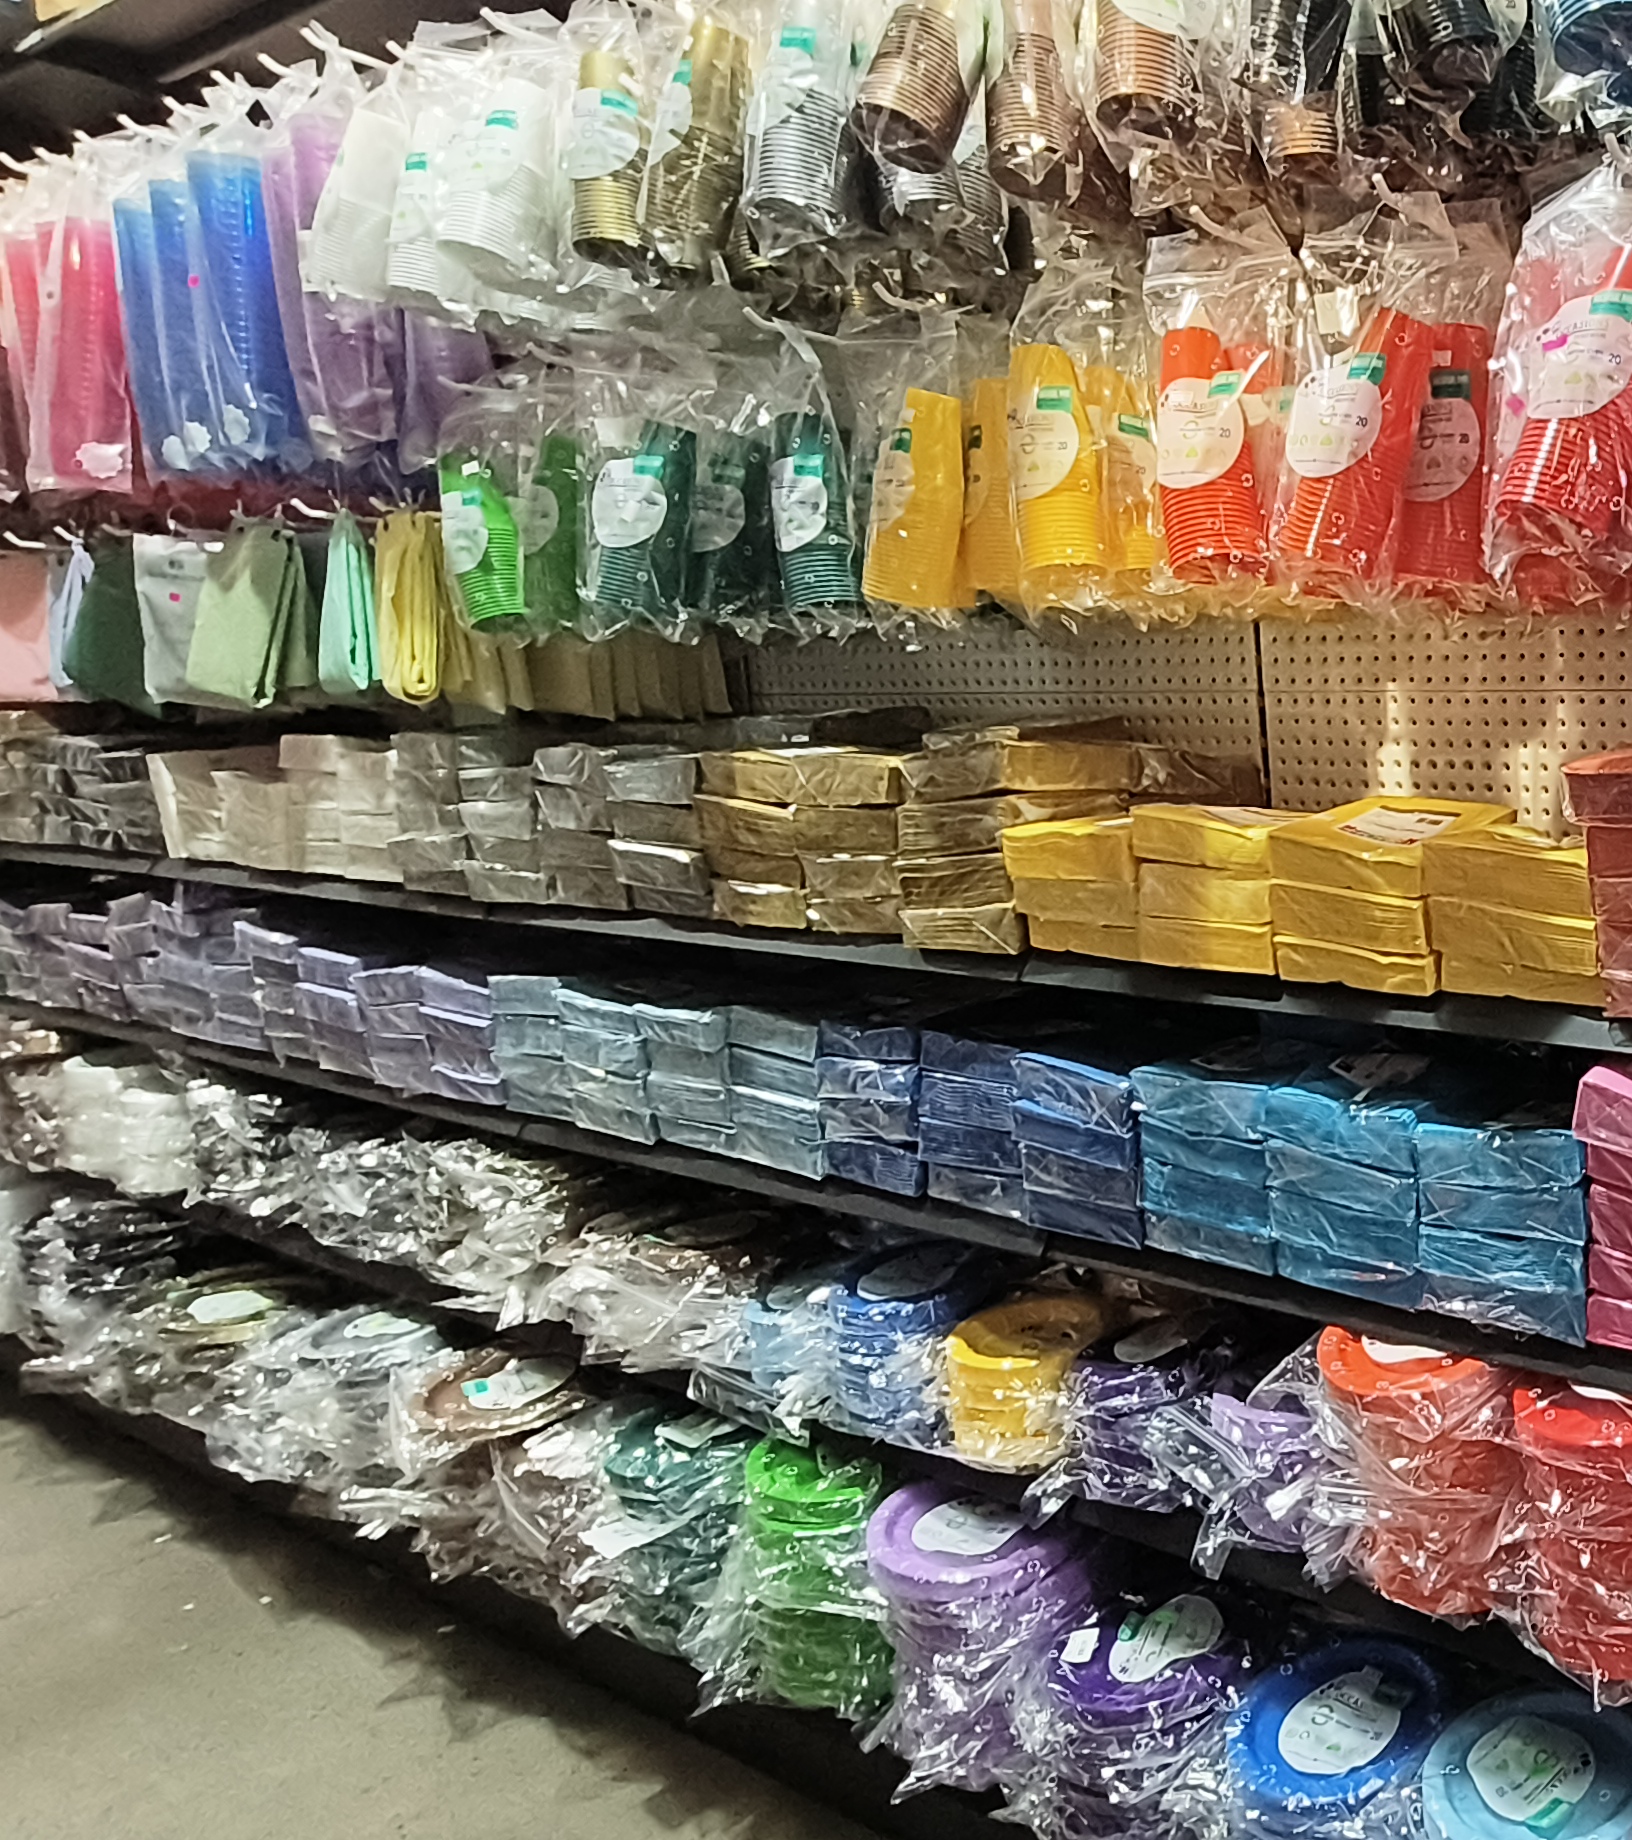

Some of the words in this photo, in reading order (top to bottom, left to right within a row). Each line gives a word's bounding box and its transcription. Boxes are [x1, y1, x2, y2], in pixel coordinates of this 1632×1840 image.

[1608, 352, 1622, 366] 20
[1355, 414, 1369, 429] 20
[1218, 427, 1232, 439] 20
